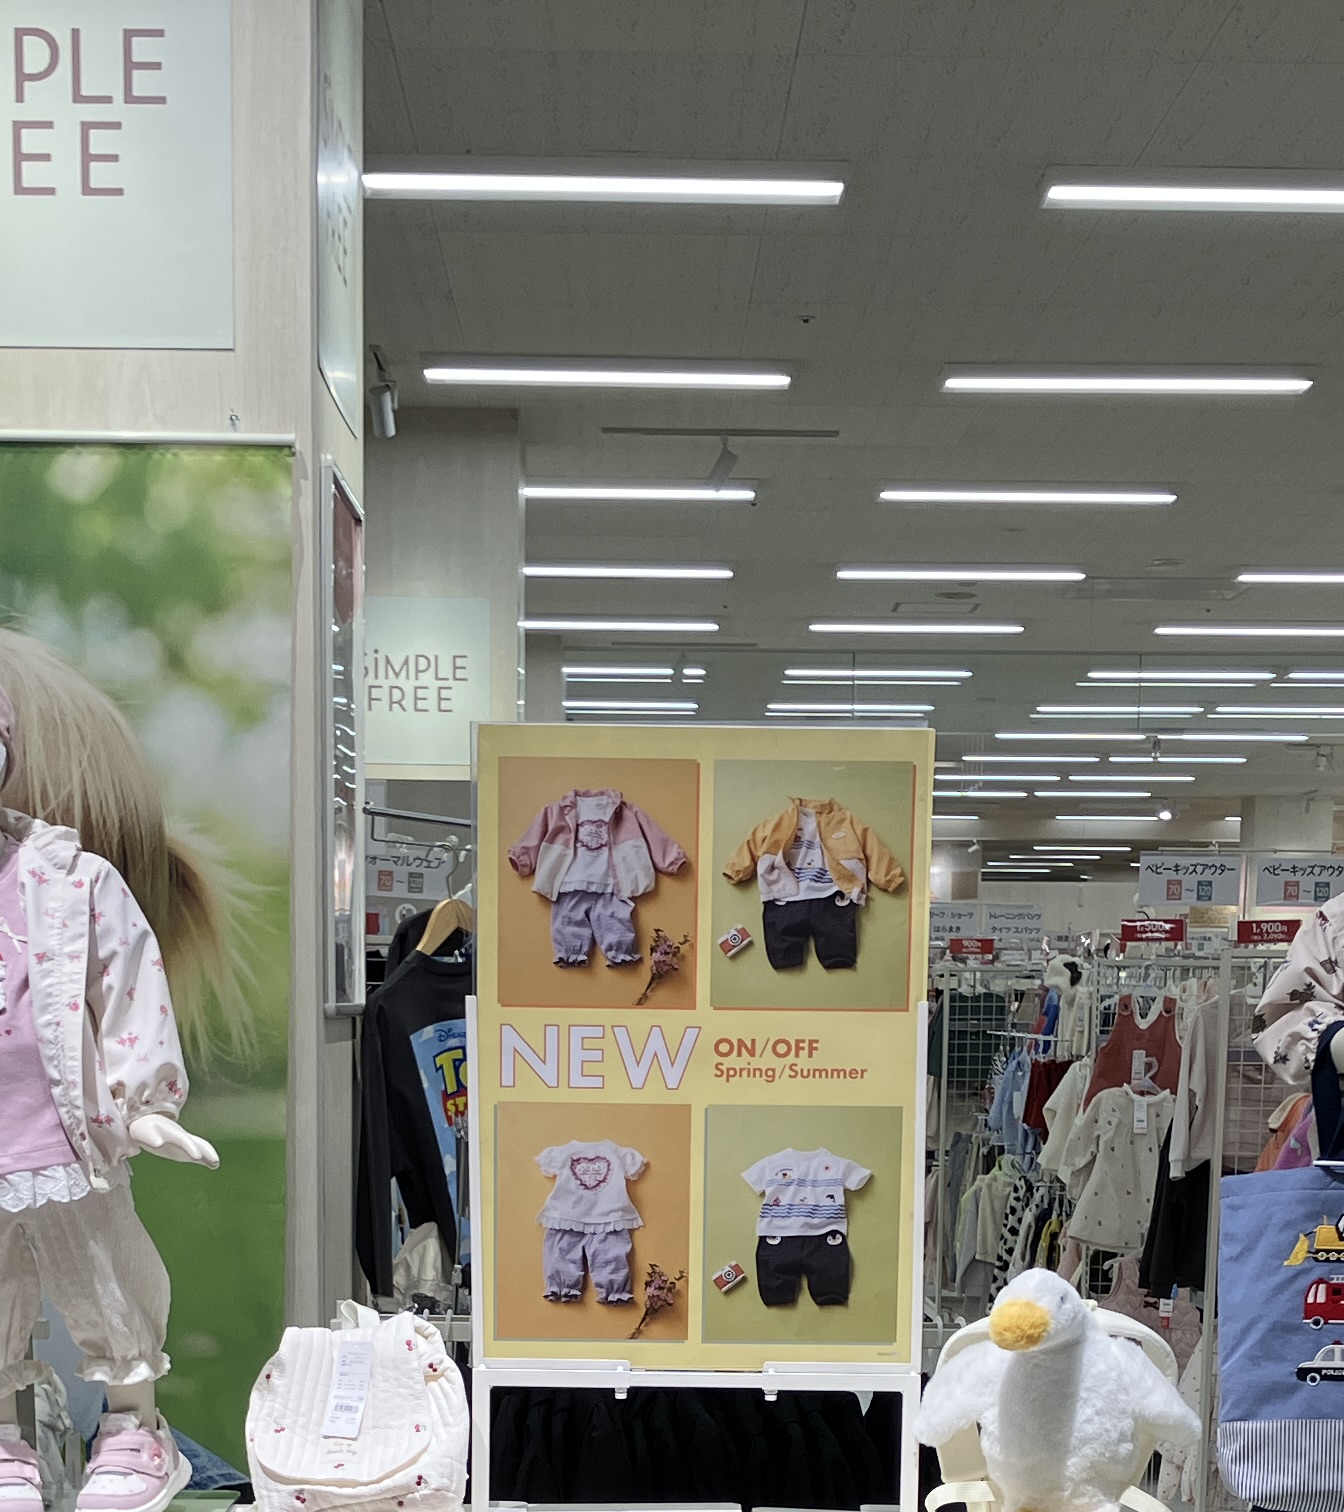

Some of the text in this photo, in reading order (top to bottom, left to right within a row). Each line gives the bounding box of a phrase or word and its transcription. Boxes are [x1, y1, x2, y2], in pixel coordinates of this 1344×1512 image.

[368, 685, 453, 712] FREE
[1145, 863, 1236, 875] ベビーキッズアウター
[1168, 886, 1212, 896] 70 120
[1286, 886, 1330, 897] 70 120
[499, 1024, 702, 1090] NEW
[713, 1037, 820, 1059] ON/OFF
[713, 1062, 868, 1083] Spring/Summer
